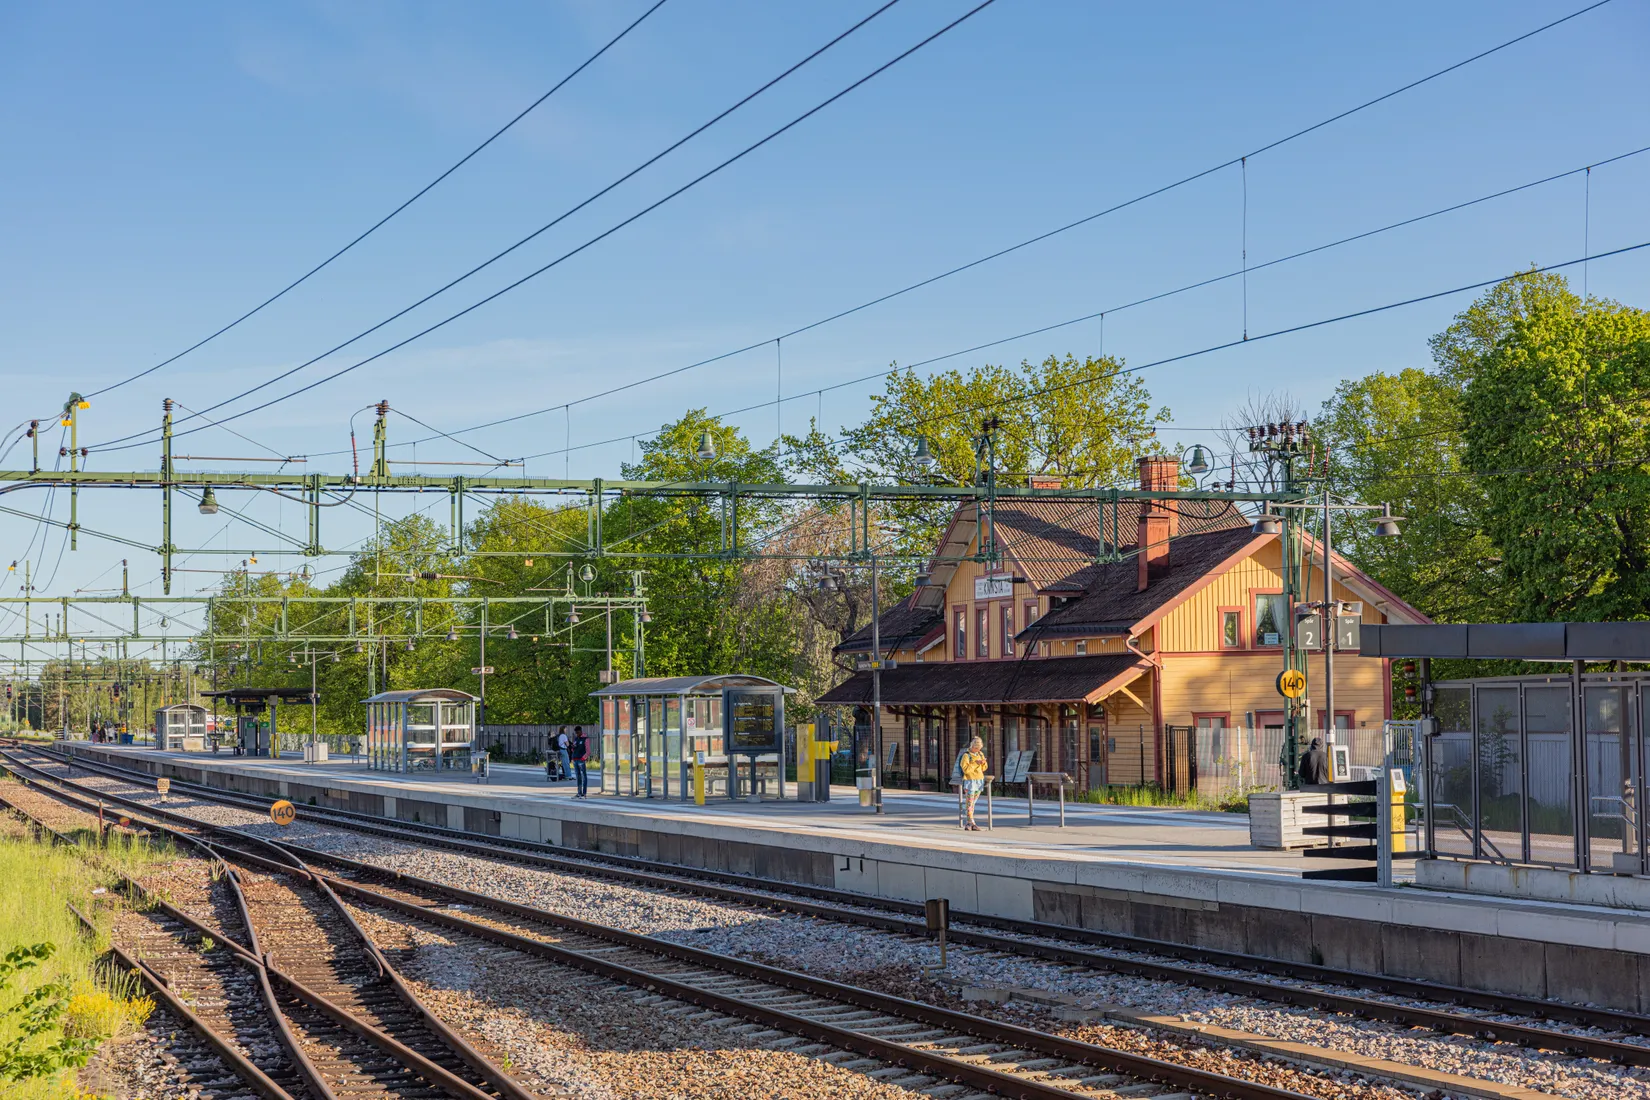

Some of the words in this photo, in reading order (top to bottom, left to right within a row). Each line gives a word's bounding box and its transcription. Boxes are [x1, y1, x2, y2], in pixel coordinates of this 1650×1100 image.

[1305, 631, 1314, 646] 2
[1346, 631, 1353, 646] 1
[1282, 677, 1305, 691] 140
[273, 806, 294, 820] 140
